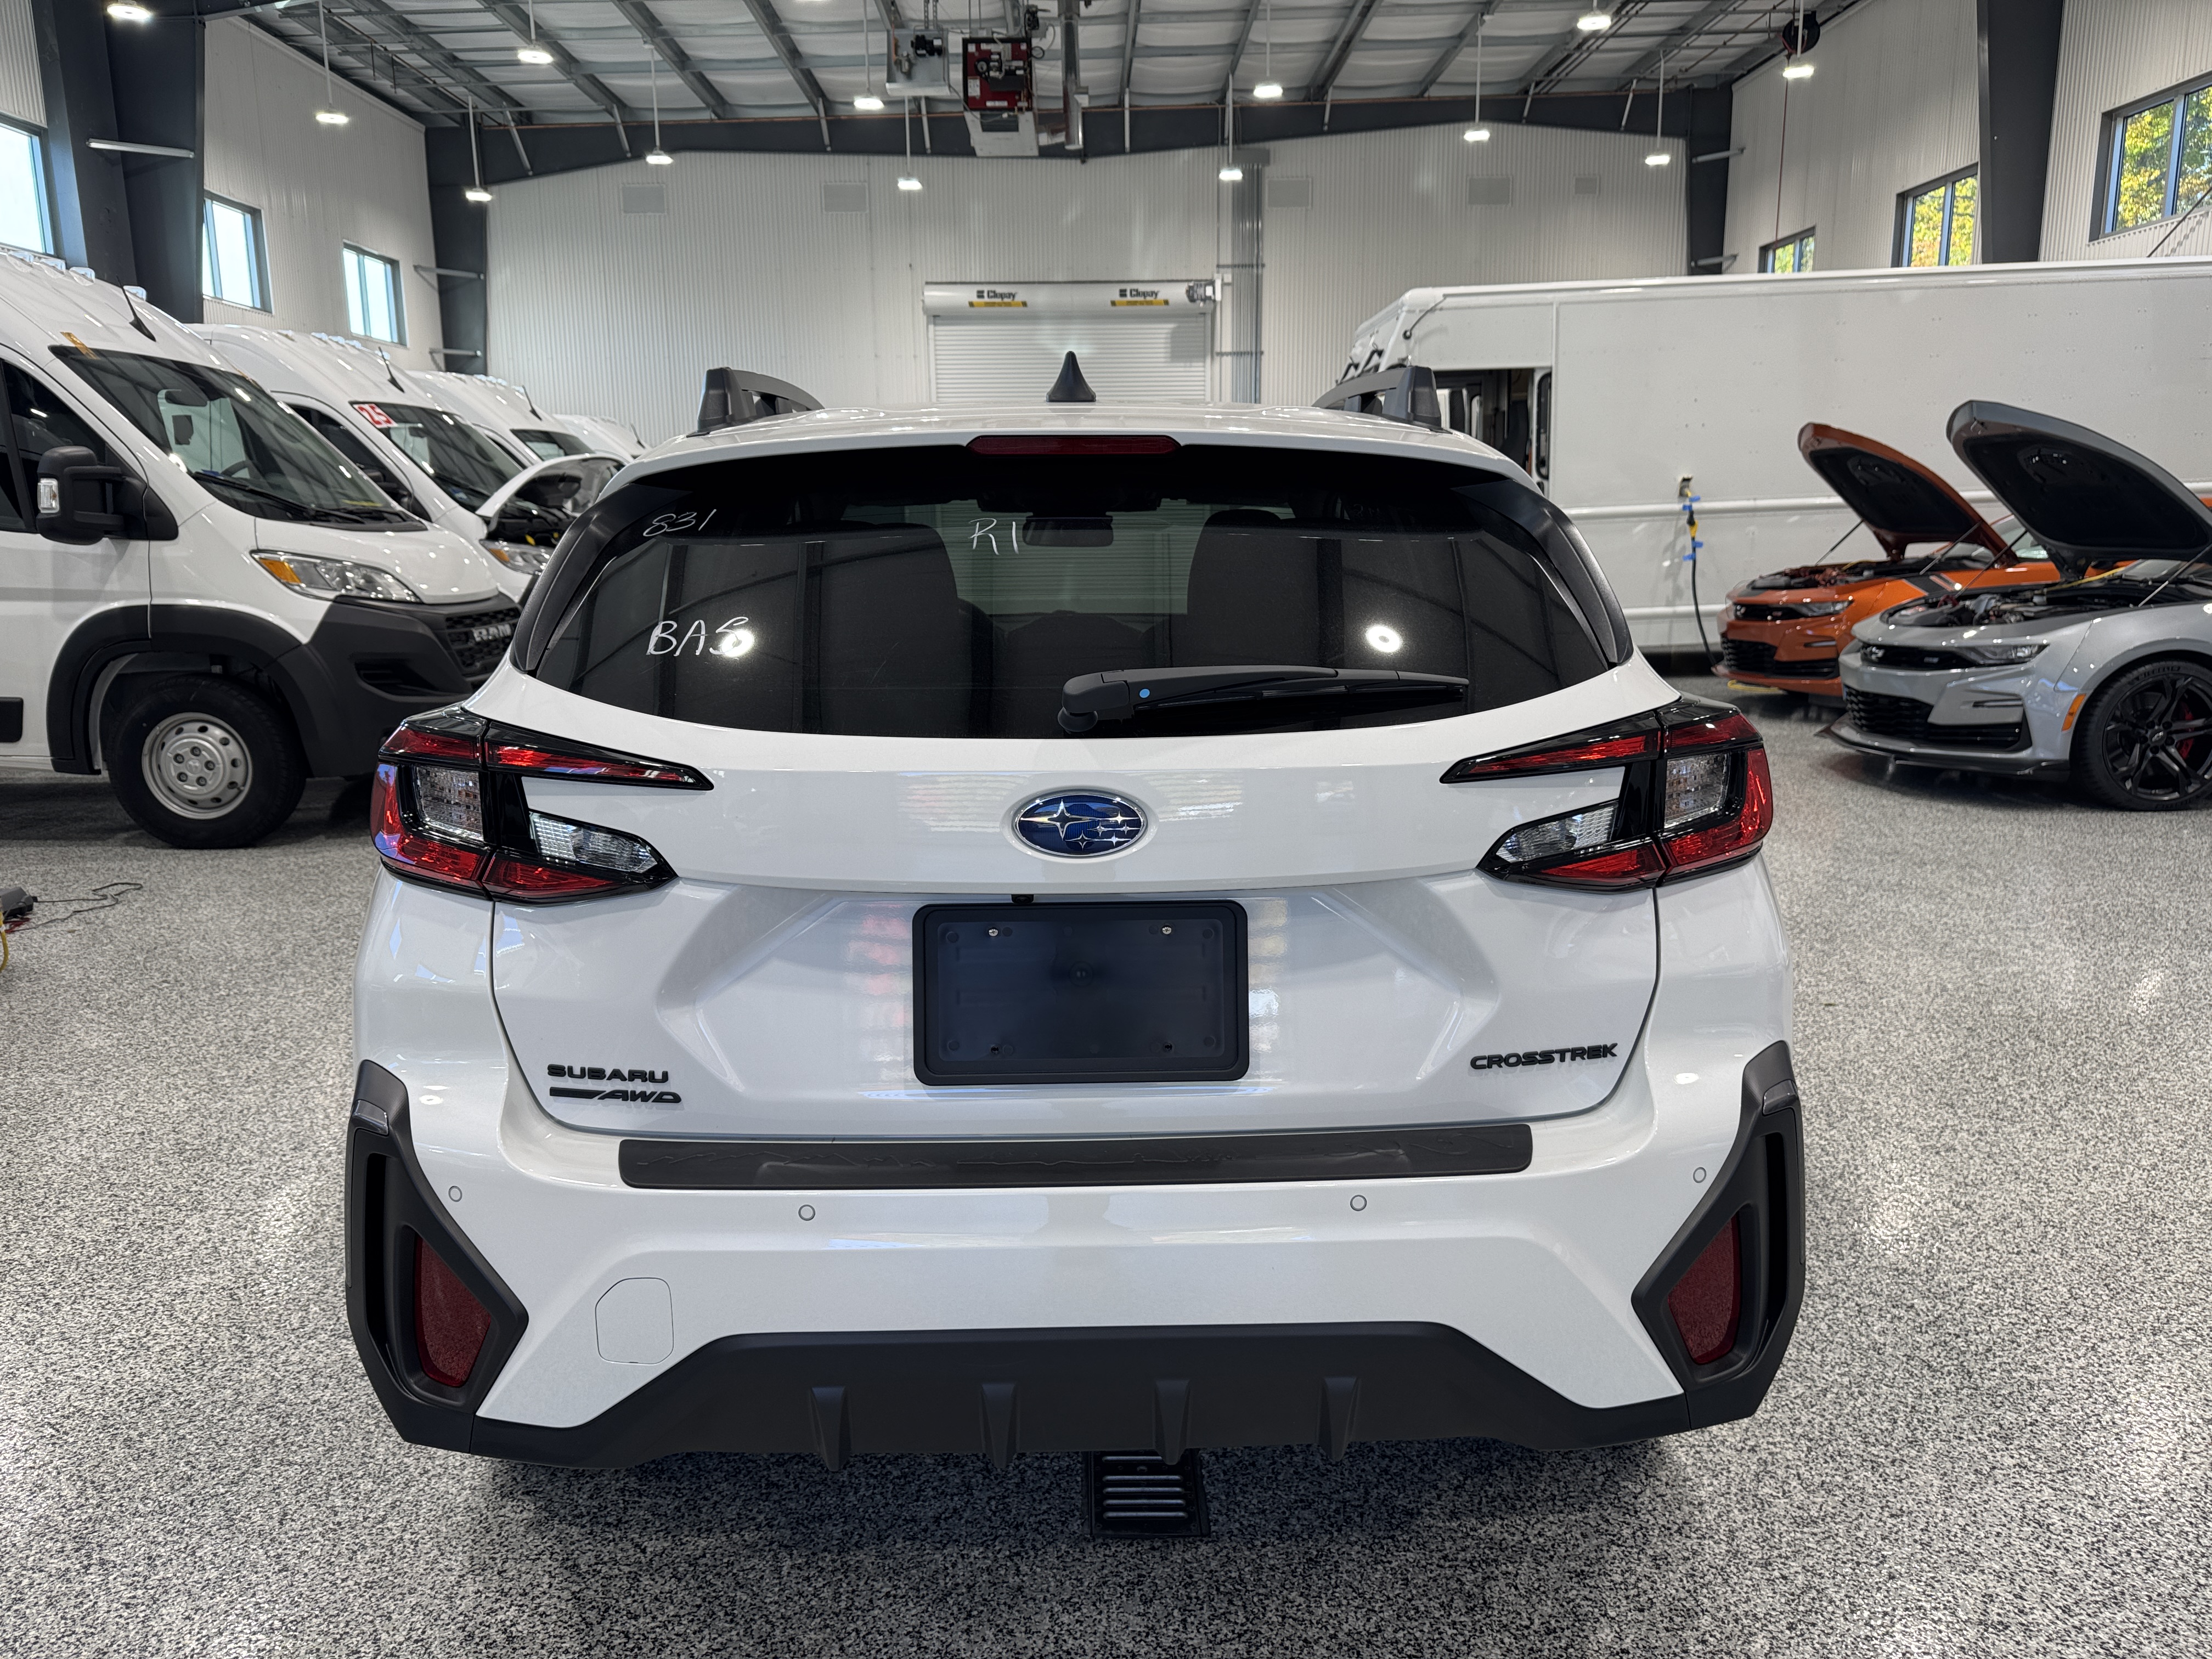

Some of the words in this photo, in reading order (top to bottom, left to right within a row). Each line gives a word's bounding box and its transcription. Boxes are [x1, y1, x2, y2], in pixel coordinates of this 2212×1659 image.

[358, 405, 392, 425] 25
[643, 509, 716, 537] 831
[472, 623, 512, 642] RAM
[646, 616, 749, 657] BAS
[1470, 1043, 1618, 1070] CROSSTREK
[547, 1064, 669, 1084] SUBARU
[597, 1090, 682, 1103] AWD
